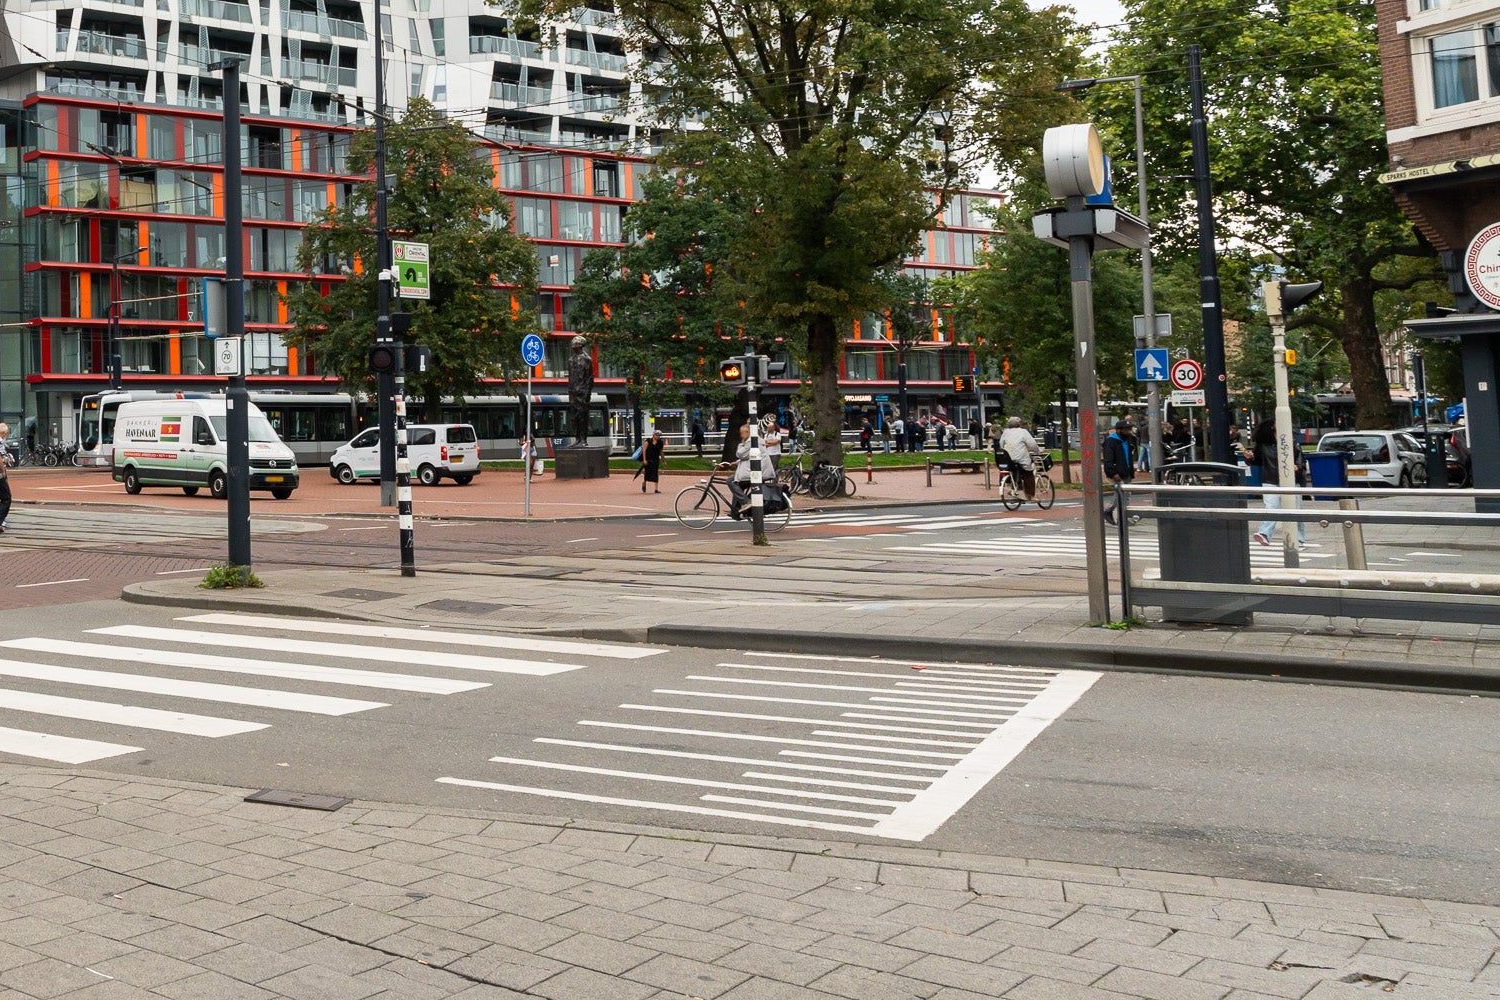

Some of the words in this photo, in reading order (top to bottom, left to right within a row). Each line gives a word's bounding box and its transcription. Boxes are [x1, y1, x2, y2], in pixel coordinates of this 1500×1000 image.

[1386, 172, 1407, 181] SPARKS
[1409, 168, 1430, 177] HOSTEL
[223, 352, 231, 361] 70
[1177, 369, 1197, 381] 30
[125, 428, 156, 438] HAVENAAR
